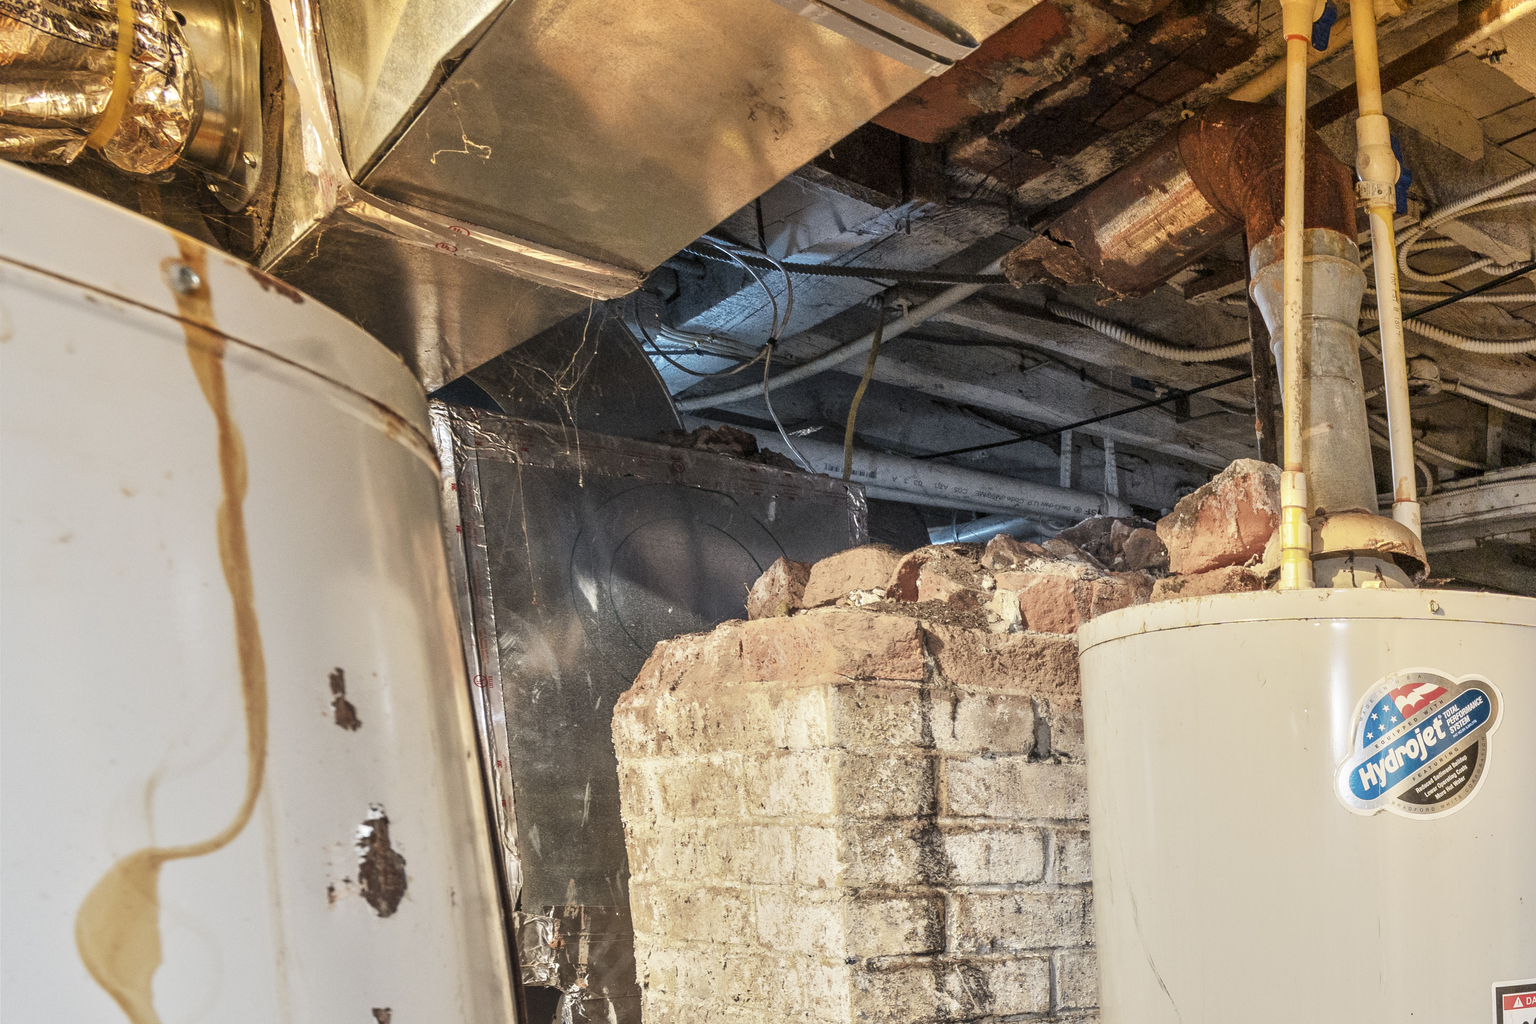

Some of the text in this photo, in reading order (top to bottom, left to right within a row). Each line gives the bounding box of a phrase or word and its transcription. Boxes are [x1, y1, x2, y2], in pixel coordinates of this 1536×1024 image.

[1374, 699, 1445, 749] EQUIPPED WITH
[1443, 704, 1460, 719] TOTAL
[1447, 695, 1484, 726] PERFORMANCE
[1449, 715, 1471, 734] SYSTEM
[1391, 736, 1486, 813] BRADFORD WHITE CORPORATION
[1412, 747, 1459, 782] FEATURING
[1424, 785, 1439, 798] Lower
[1455, 765, 1468, 777] Costs
